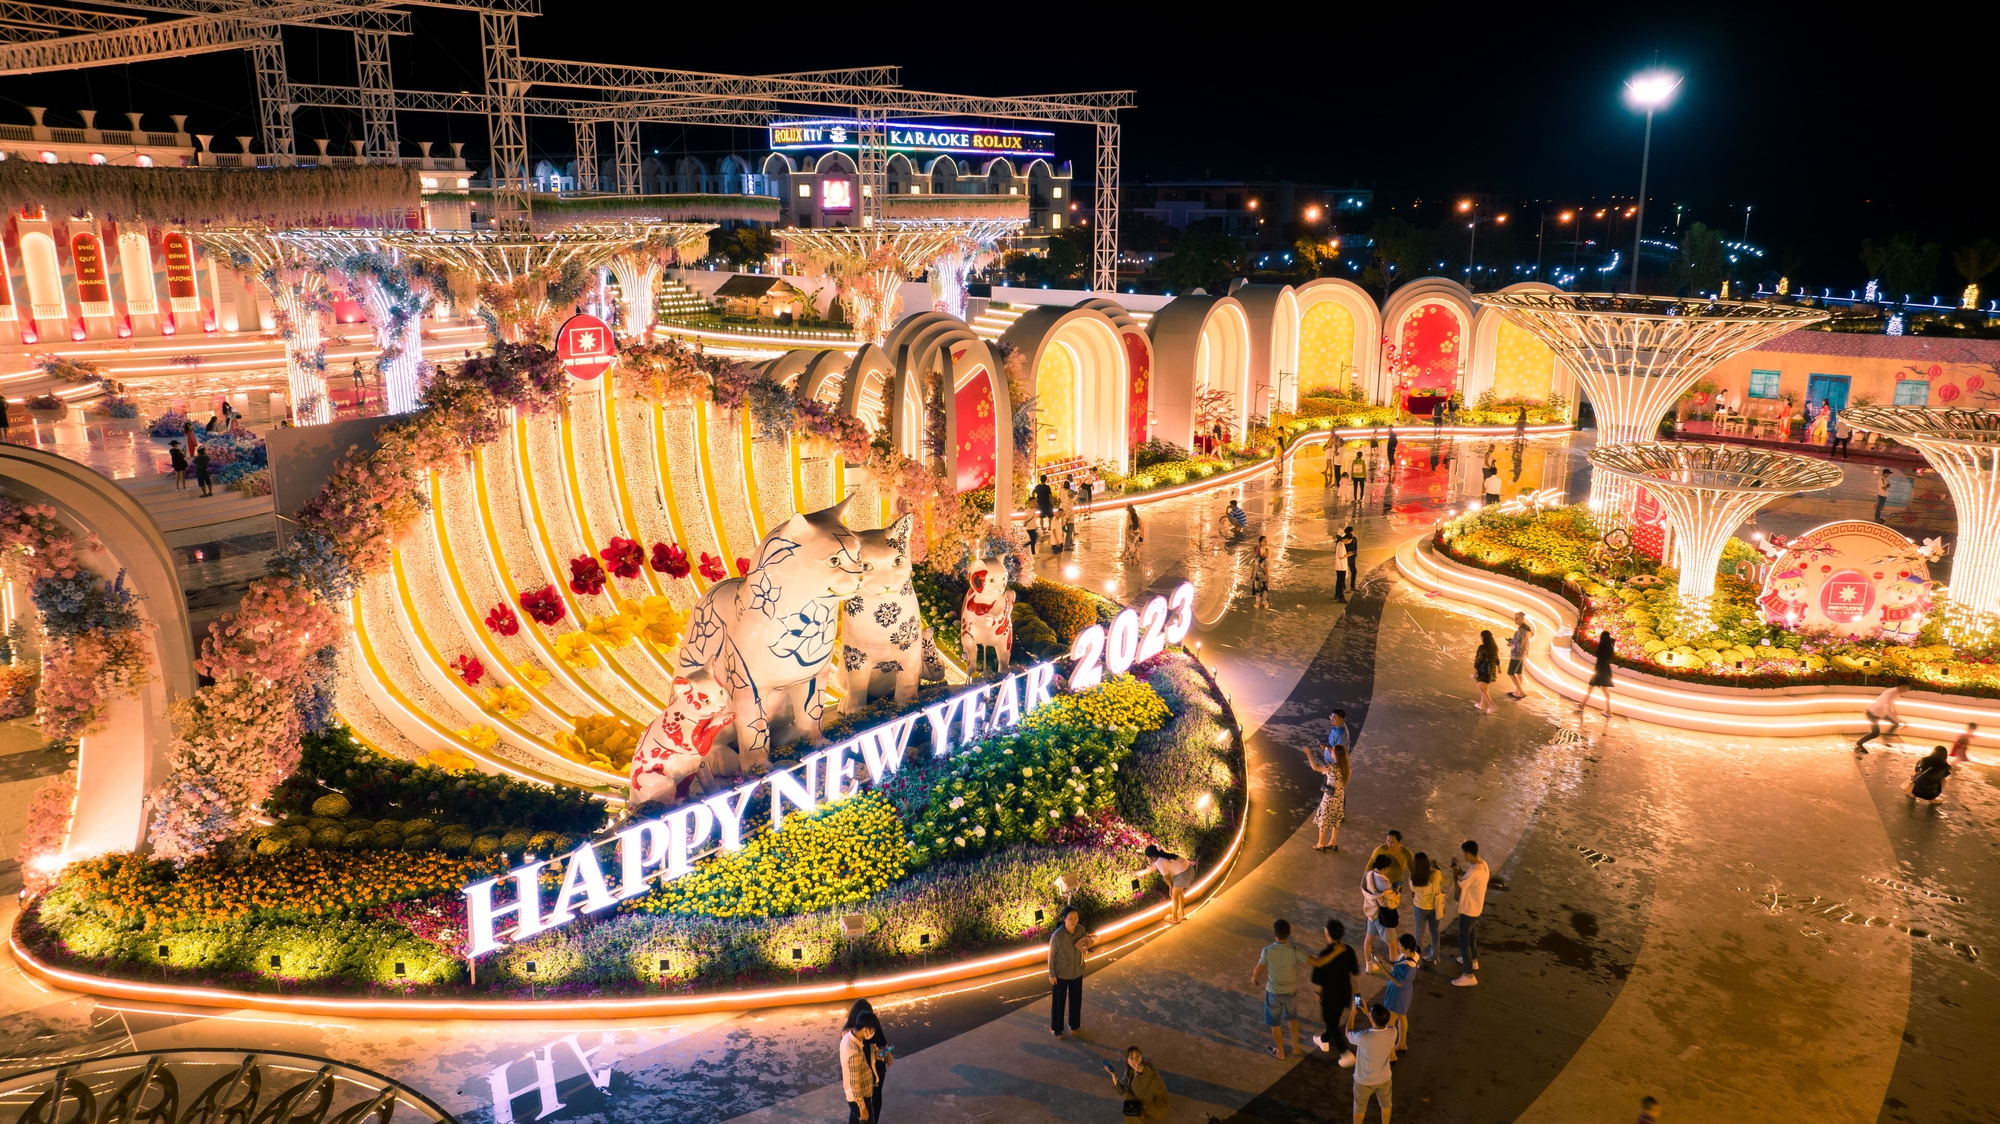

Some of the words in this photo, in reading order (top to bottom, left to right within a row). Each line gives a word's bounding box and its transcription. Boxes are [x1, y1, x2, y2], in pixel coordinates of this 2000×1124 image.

[774, 129, 803, 142] ROLUX
[803, 128, 823, 141] KTV
[890, 130, 970, 147] KARAOKE
[973, 134, 1022, 149] ROLUX
[460, 776, 766, 959] HAPPY
[763, 710, 921, 831] NEW
[921, 661, 1055, 757] YEAR
[1067, 580, 1196, 693] 2023
